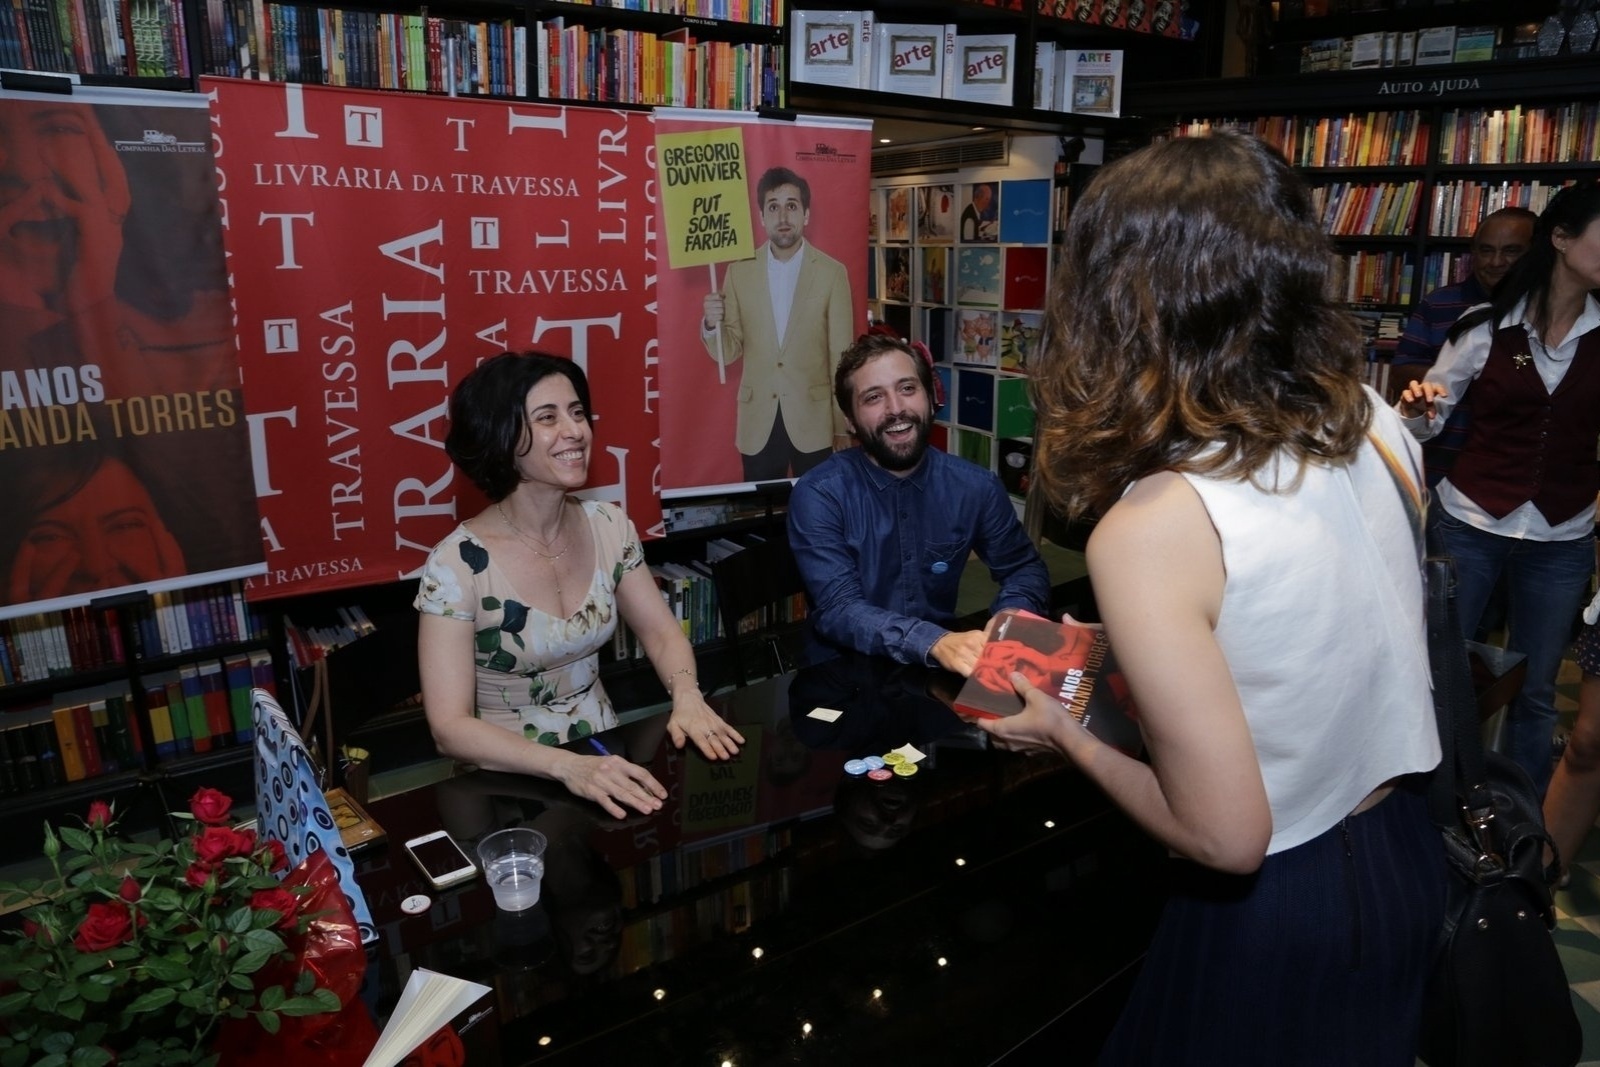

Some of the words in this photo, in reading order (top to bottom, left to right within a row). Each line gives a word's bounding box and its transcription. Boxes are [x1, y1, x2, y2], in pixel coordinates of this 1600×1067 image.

[808, 29, 850, 58] arte
[862, 19, 871, 43] arte
[945, 32, 954, 54] arte
[894, 41, 933, 68] arte
[967, 50, 1004, 78] arte
[1078, 52, 1112, 62] ARTE
[1378, 81, 1423, 94] AUTO
[1429, 78, 1480, 96] AJUDA
[349, 110, 378, 142] T
[446, 117, 475, 151] T
[664, 142, 740, 167] GREGORIO
[254, 163, 403, 190] LIVRARIA
[412, 174, 445, 192] DA
[451, 173, 580, 197] TRAVESSA
[693, 193, 722, 215] PUT
[535, 219, 570, 249] L
[688, 213, 731, 234] SOME
[258, 211, 315, 269] T
[684, 228, 738, 252] FAROFA
[468, 268, 628, 295] TRAVESSA
[1, 364, 105, 410] ANOS
[104, 388, 237, 438] TORRES
[319, 300, 366, 541] TRAVESSA
[261, 557, 364, 587] TRAVESSA
[1059, 668, 1084, 700] ANOS
